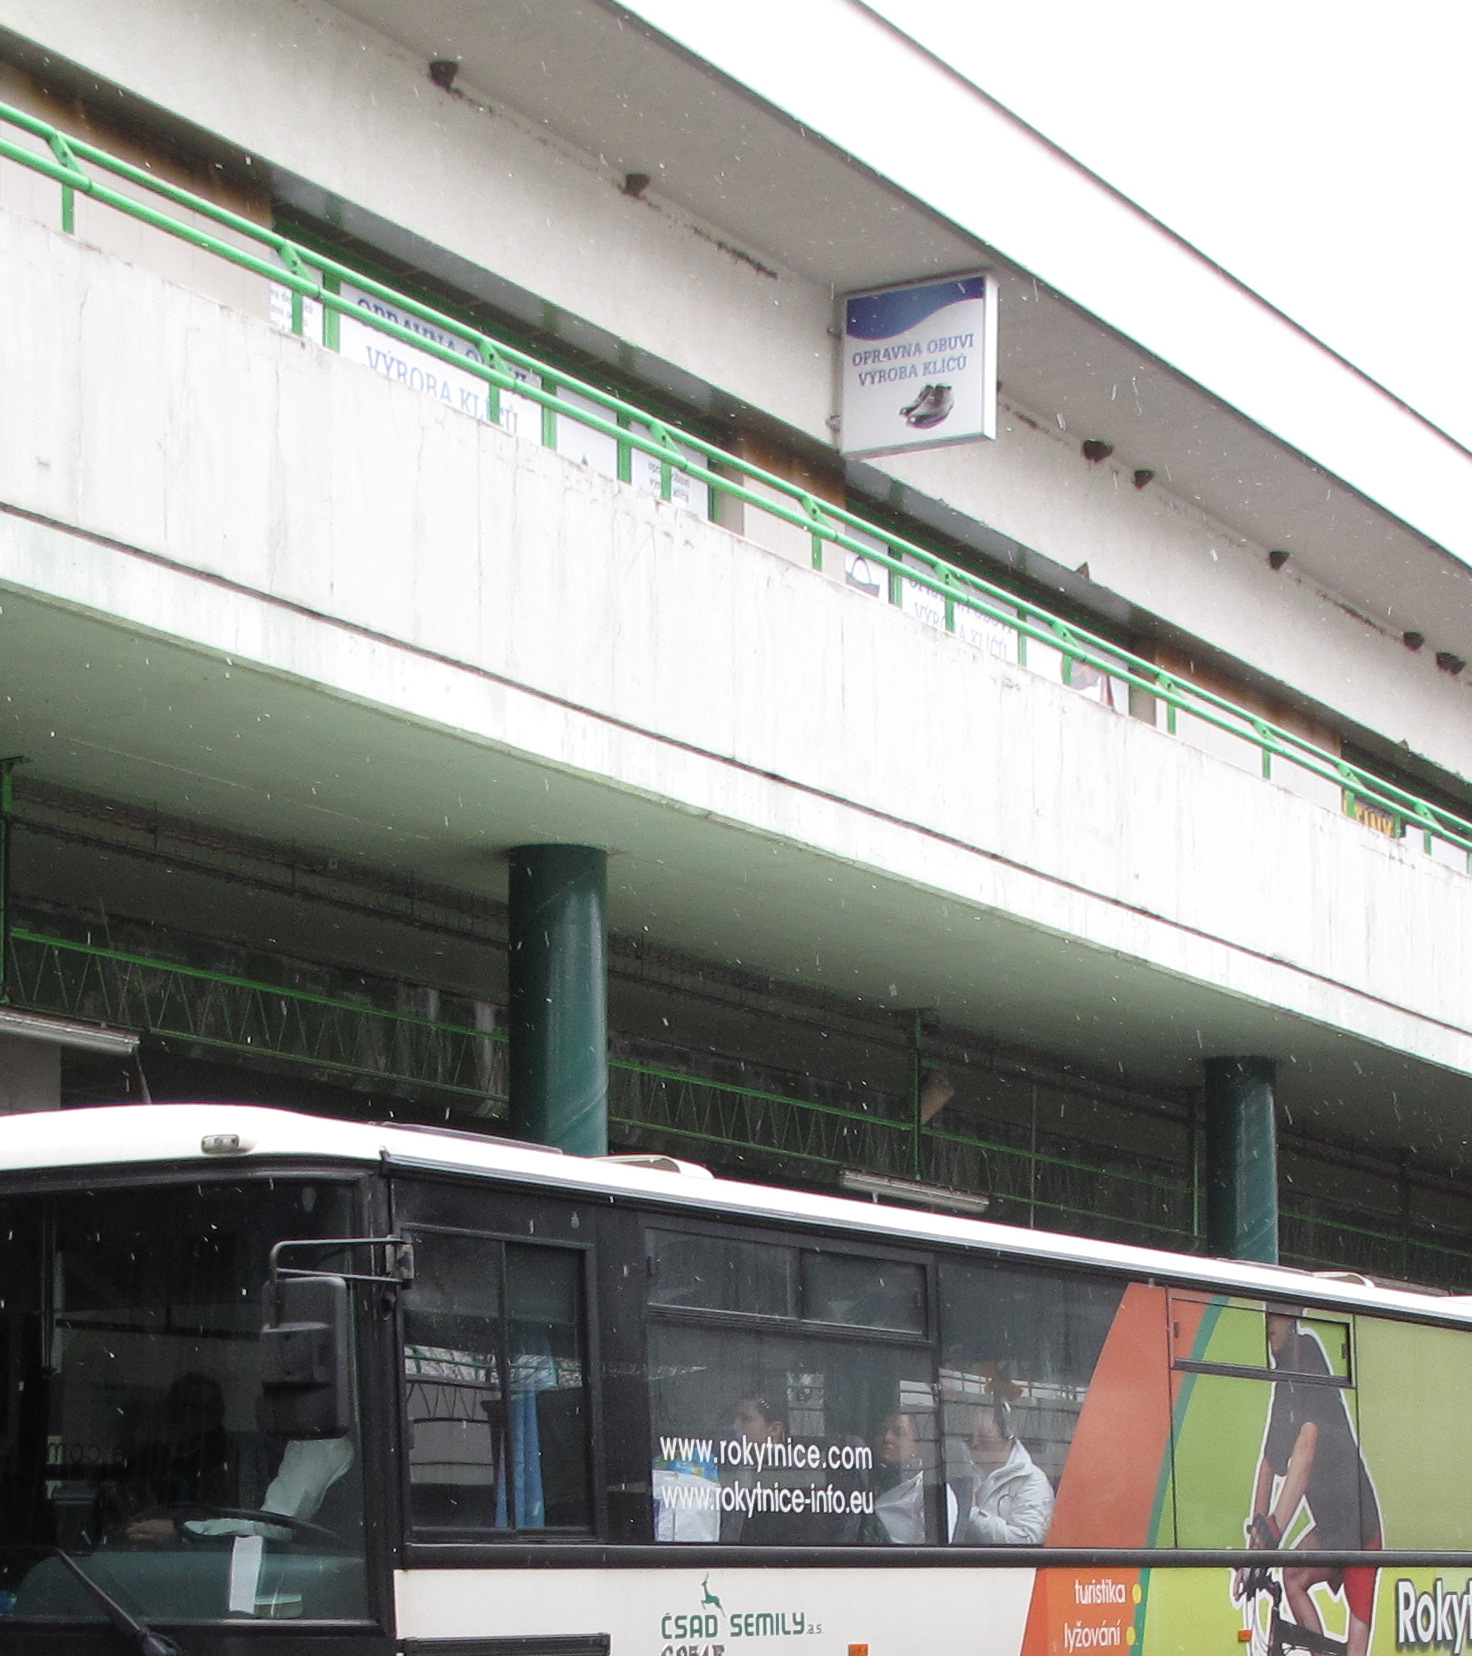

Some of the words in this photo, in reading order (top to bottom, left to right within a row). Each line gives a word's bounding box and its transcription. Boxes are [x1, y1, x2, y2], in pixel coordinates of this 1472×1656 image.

[852, 342, 922, 367] OPRAVNA
[927, 333, 974, 354] OBUVI
[660, 1435, 873, 1473] www.rokytnice.com
[662, 1481, 874, 1519] www.rokytnice-info.eu
[1075, 1579, 1126, 1604] turistika
[730, 1612, 805, 1637] SEMILY
[1064, 1619, 1121, 1653] lyžování
